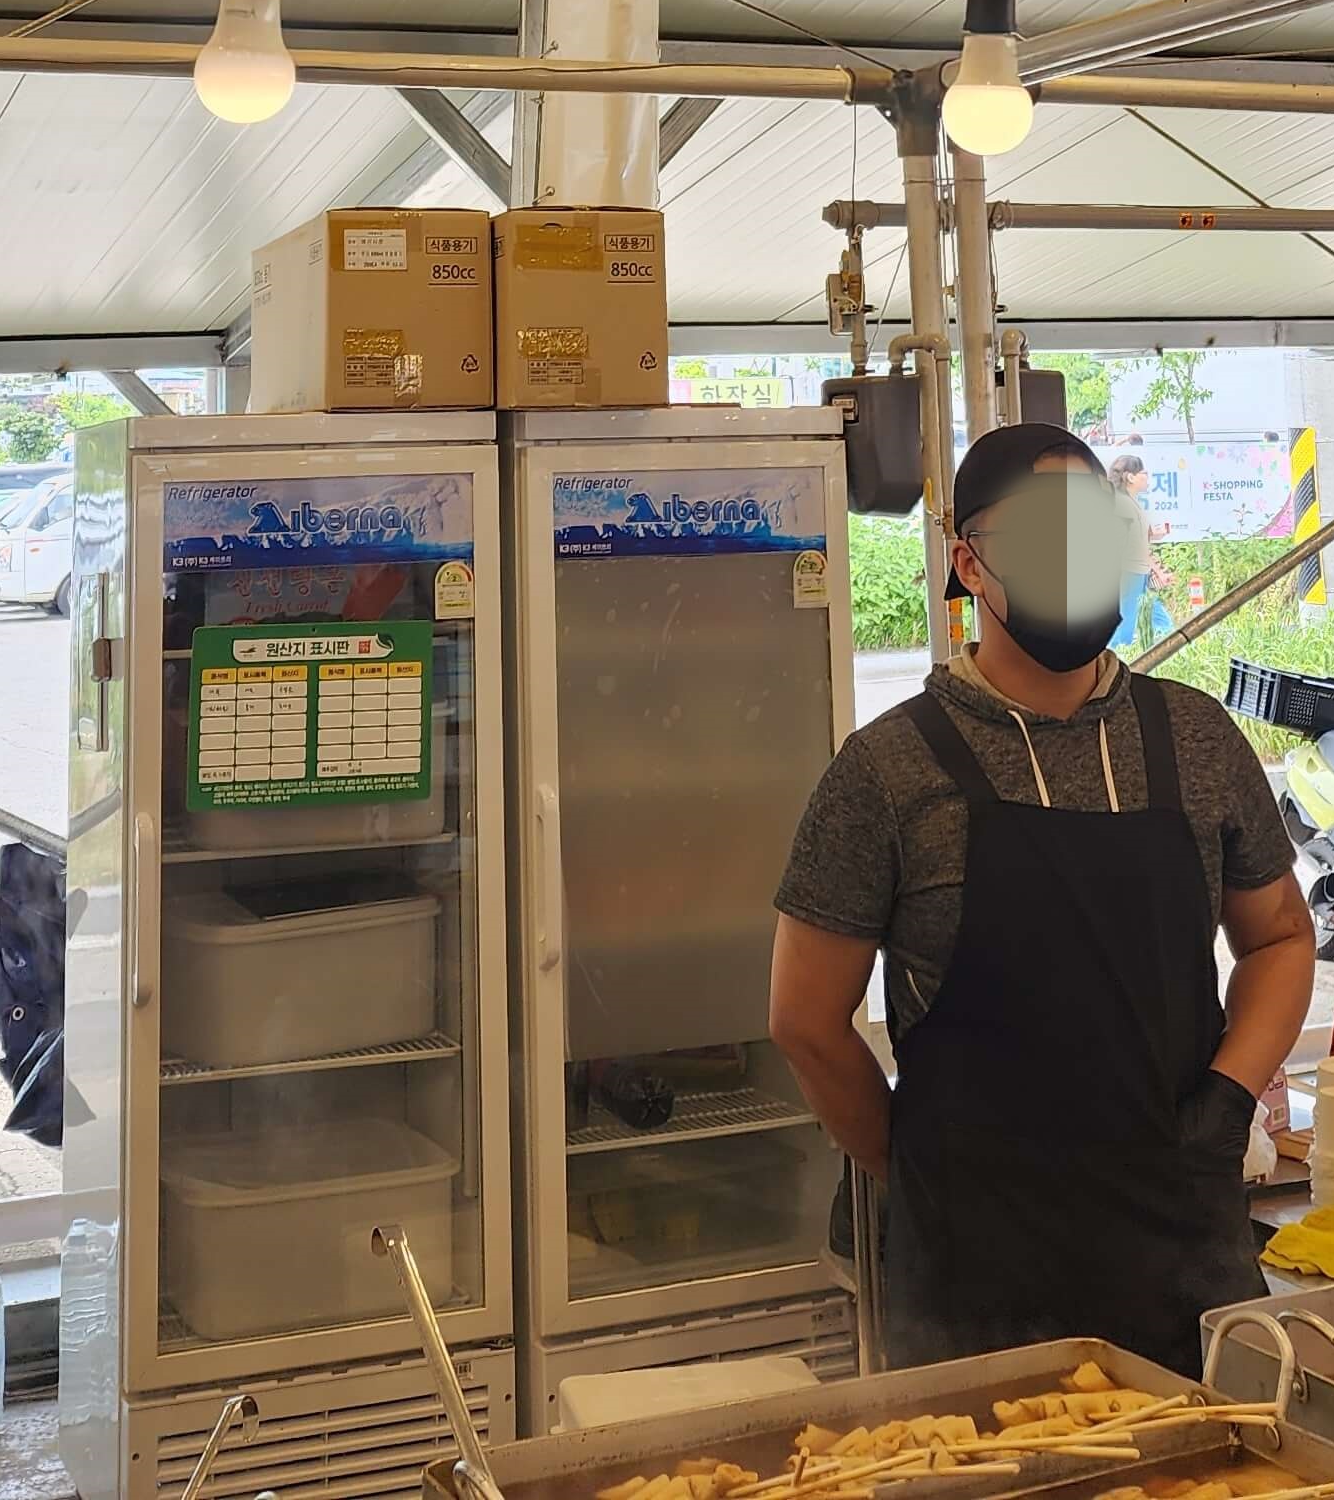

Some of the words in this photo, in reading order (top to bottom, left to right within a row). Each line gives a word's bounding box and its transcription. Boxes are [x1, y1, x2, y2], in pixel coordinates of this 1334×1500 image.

[429, 238, 473, 252] 식품용기
[609, 236, 650, 250] 식품용기
[432, 265, 475, 279] 850cc
[611, 263, 653, 277] 850cc
[554, 476, 634, 493] Refrigerator
[1202, 479, 1264, 492] K-SHOPPING
[168, 485, 258, 502] Refrigerator
[1203, 492, 1234, 501] FESTA
[1154, 501, 1179, 511] 2024
[266, 641, 306, 658] 원산지
[309, 639, 350, 656] 표시판
